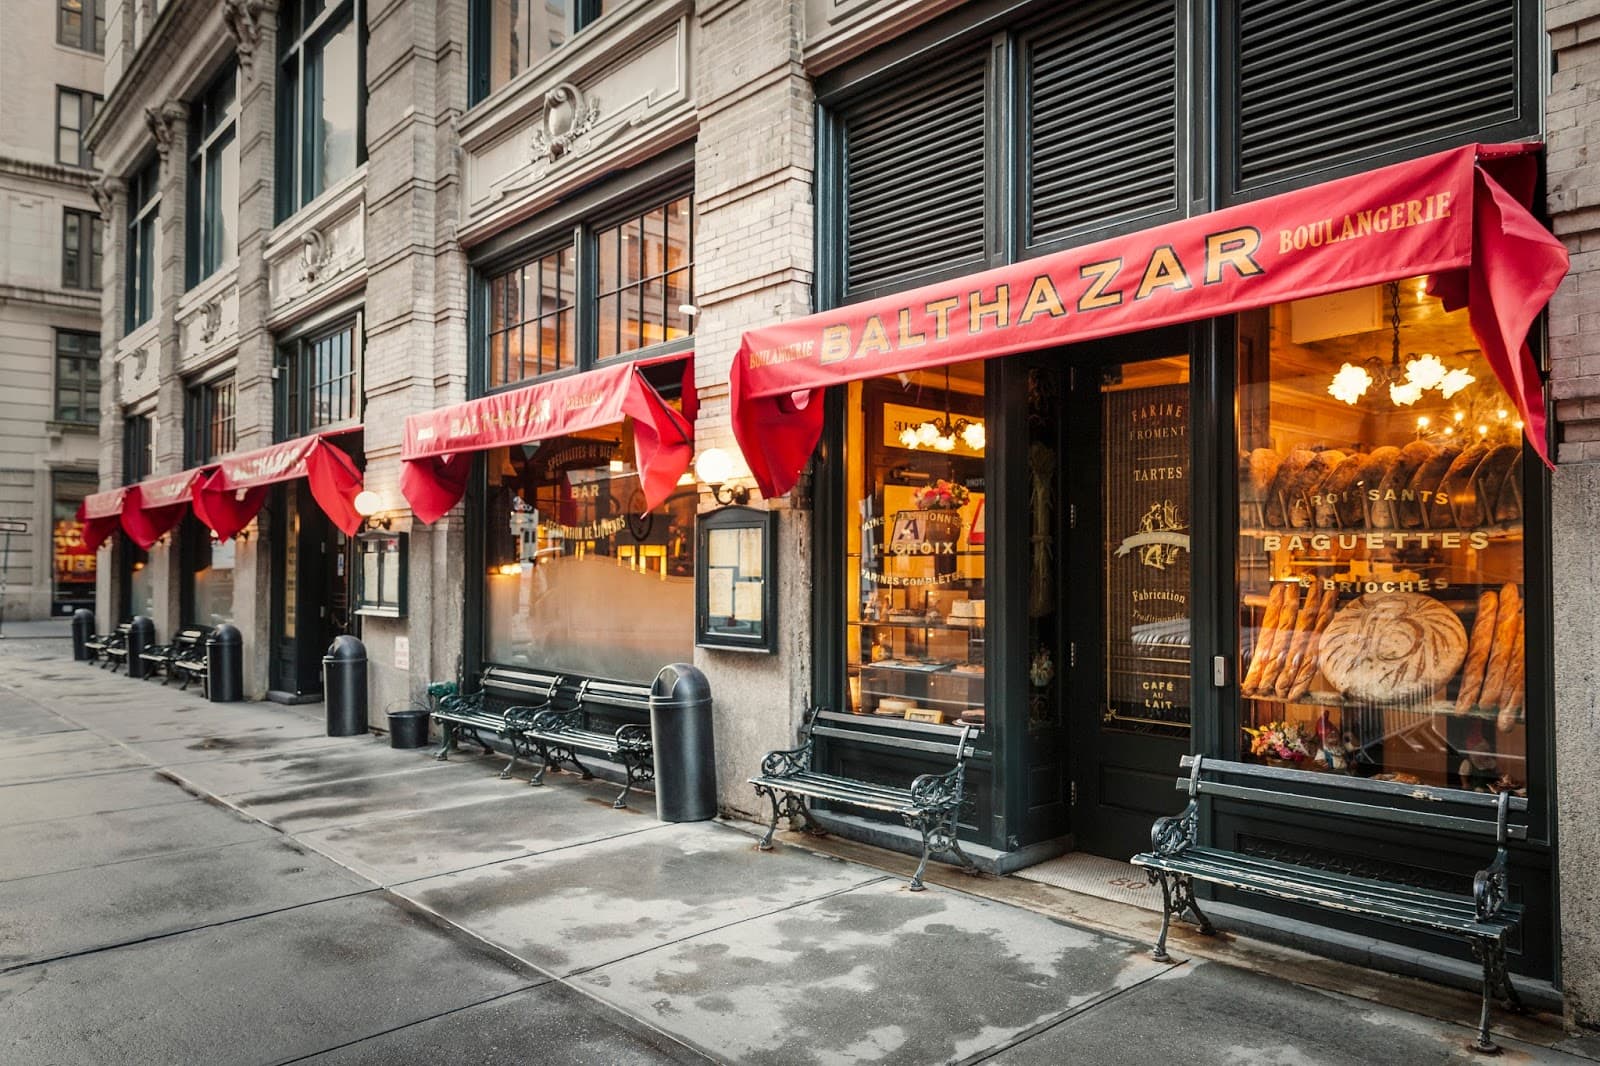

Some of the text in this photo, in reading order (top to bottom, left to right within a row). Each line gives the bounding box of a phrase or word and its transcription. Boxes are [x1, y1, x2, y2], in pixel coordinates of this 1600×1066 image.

[819, 225, 1265, 365] BALTHAZAR
[1278, 191, 1452, 255] BOULANGERIE
[450, 400, 550, 438] BALTHAZAR
[1132, 403, 1183, 422] FARINE
[1134, 466, 1183, 481] TARTES
[571, 484, 599, 498] BAR
[893, 542, 954, 555] CHOIX
[1263, 531, 1490, 552] BAGUETTES
[1298, 576, 1449, 594] & BRIOCHES
[1132, 588, 1185, 604] Fabrication
[1142, 681, 1175, 692] CAFÉ
[1145, 699, 1173, 709] LAIT
